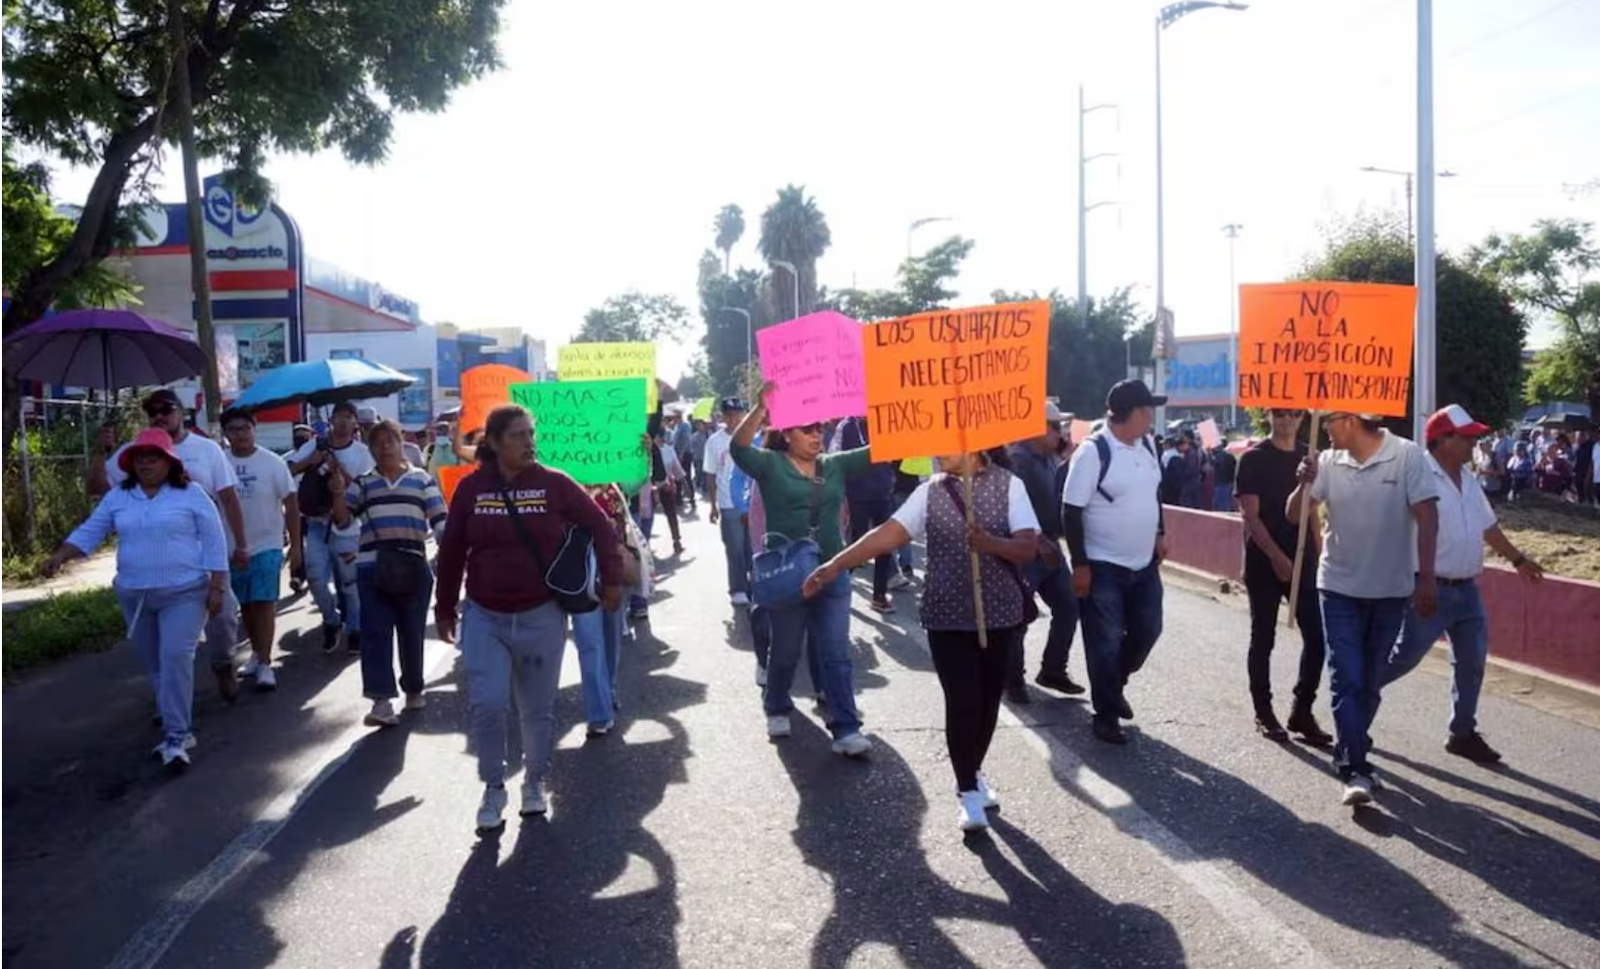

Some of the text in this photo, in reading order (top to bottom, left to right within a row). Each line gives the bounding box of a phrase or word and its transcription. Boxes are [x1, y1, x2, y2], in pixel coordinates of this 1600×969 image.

[1300, 290, 1339, 317] NO
[876, 320, 915, 347] LOS
[928, 309, 1032, 345] USUARIOS
[1279, 317, 1348, 339] A LA
[1253, 336, 1394, 368] IMPOSICIÓN
[900, 346, 1030, 388] NECESITAMOS
[511, 388, 542, 407] NO
[1238, 371, 1410, 401] EN EL TRANSPORTE
[607, 411, 632, 425] AL
[868, 385, 1032, 435] TAXIS FORANEOS
[539, 431, 611, 445] XISMO
[535, 445, 645, 466] AXAQUEÑO
